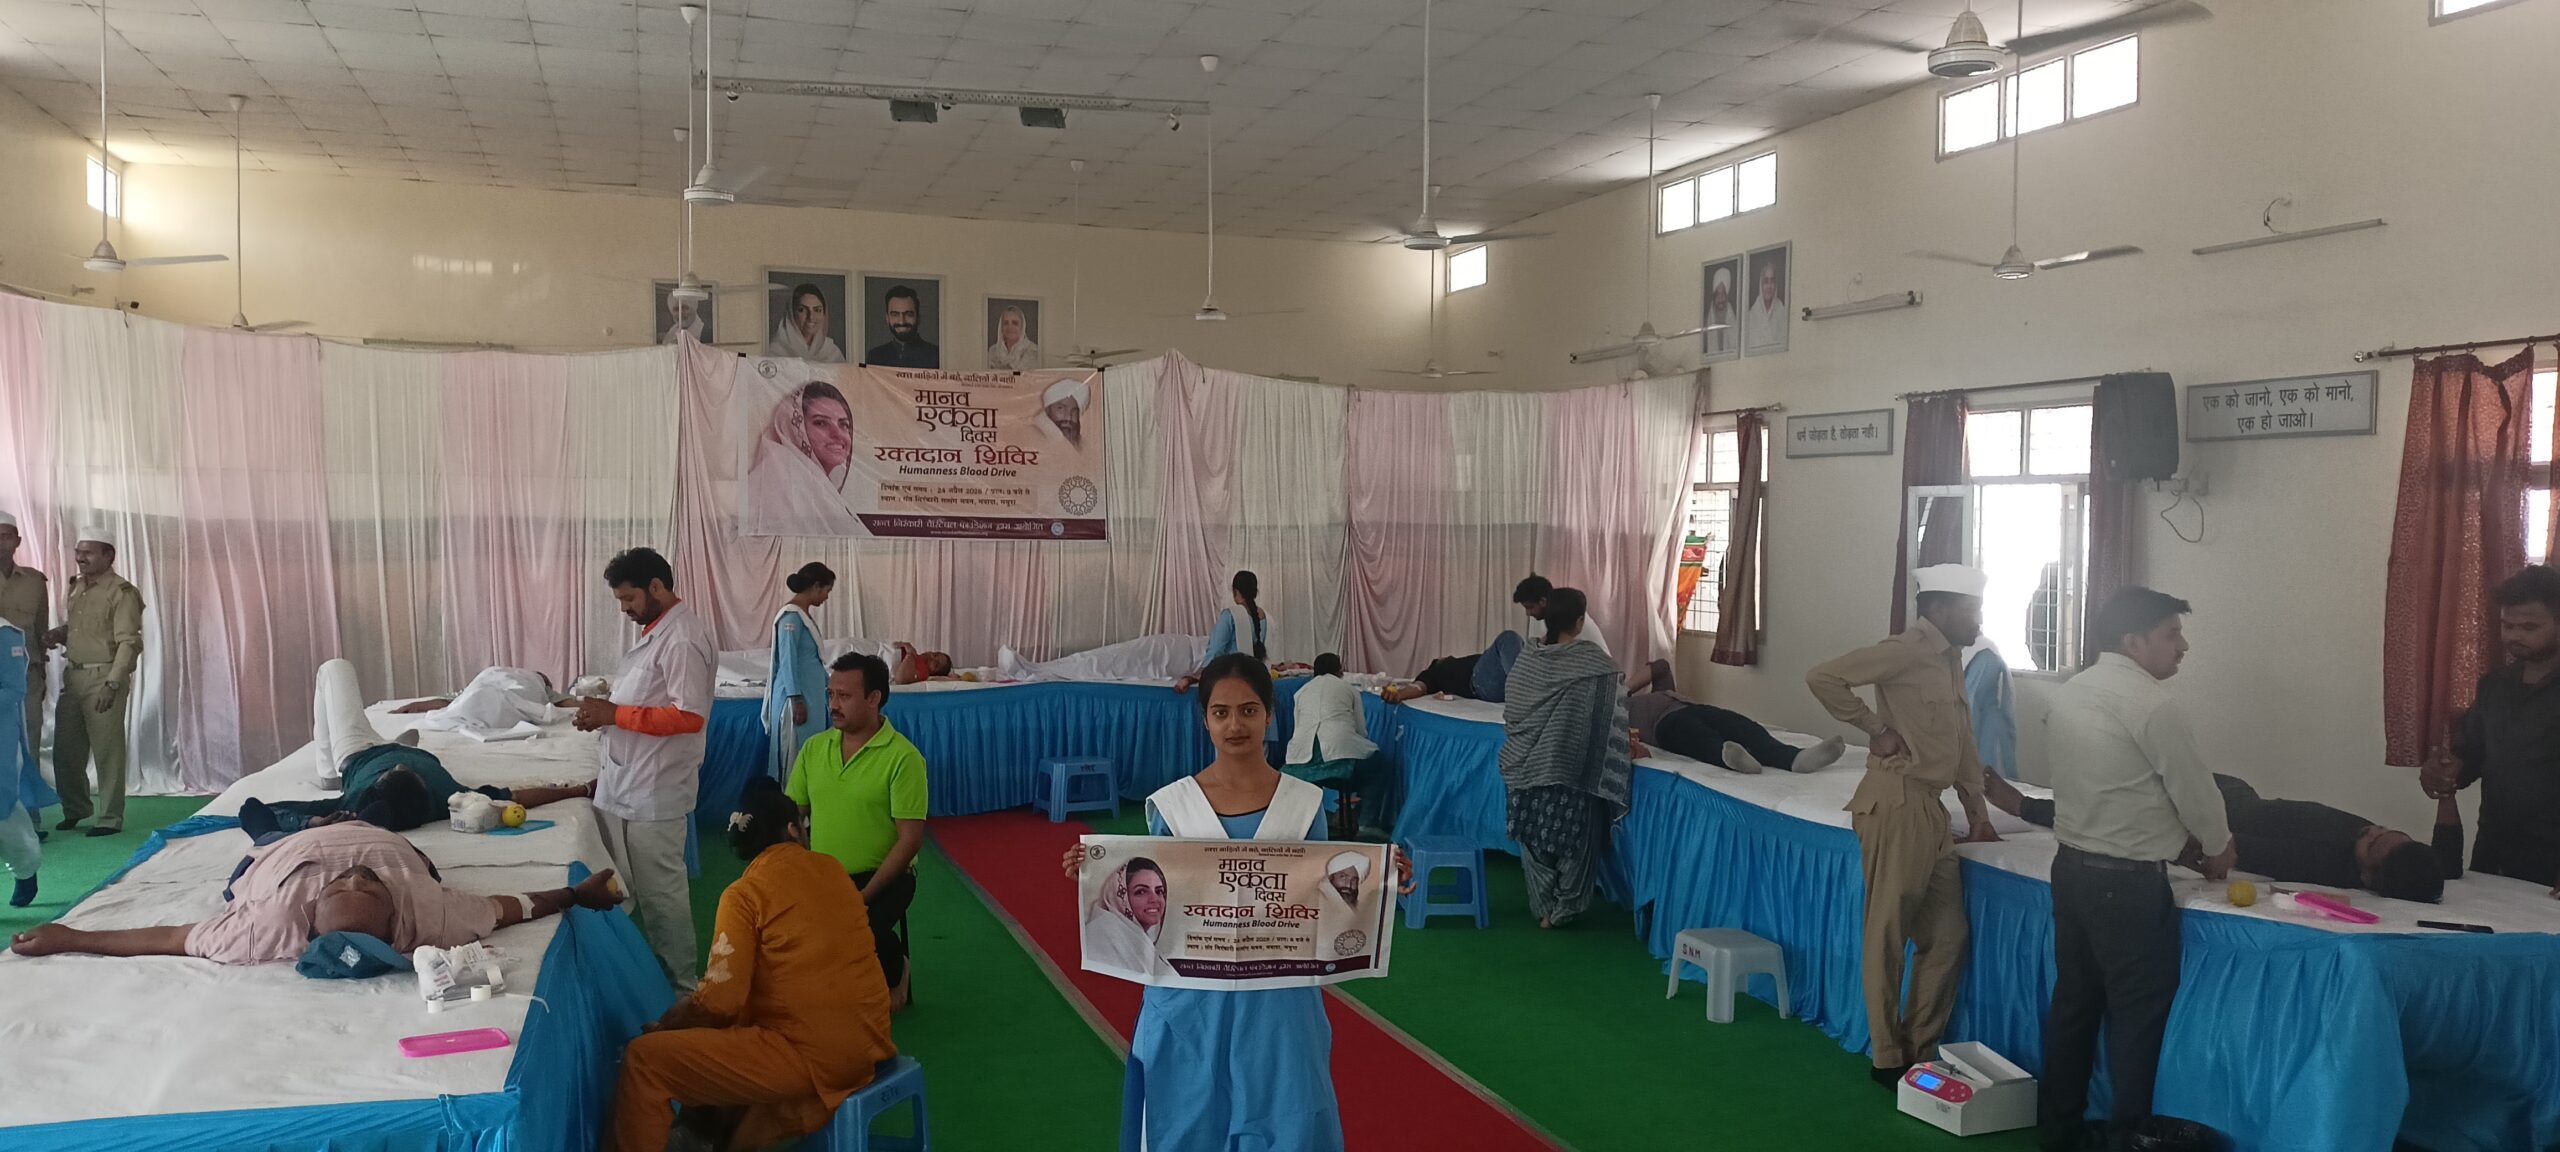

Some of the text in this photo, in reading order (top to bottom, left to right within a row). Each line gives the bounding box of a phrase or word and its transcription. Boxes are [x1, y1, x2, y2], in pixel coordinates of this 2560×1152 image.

[914, 389, 972, 406] मानव
[2202, 379, 2354, 412] एक को जानो, एक को मानो,
[916, 405, 998, 432] एकता
[2237, 416, 2255, 434] एक
[2260, 410, 2272, 430] हो
[960, 427, 998, 444] दिवस
[874, 444, 1040, 466] रक्तदान शिविर
[899, 464, 1018, 477] Humanness Blood Drive
[1218, 858, 1266, 872] मानव
[1219, 871, 1288, 893] एकता
[1254, 888, 1286, 902] दिवस
[1184, 904, 1320, 920] रक्तदान शिविर
[1202, 918, 1300, 930] Humanness Blood Drive
